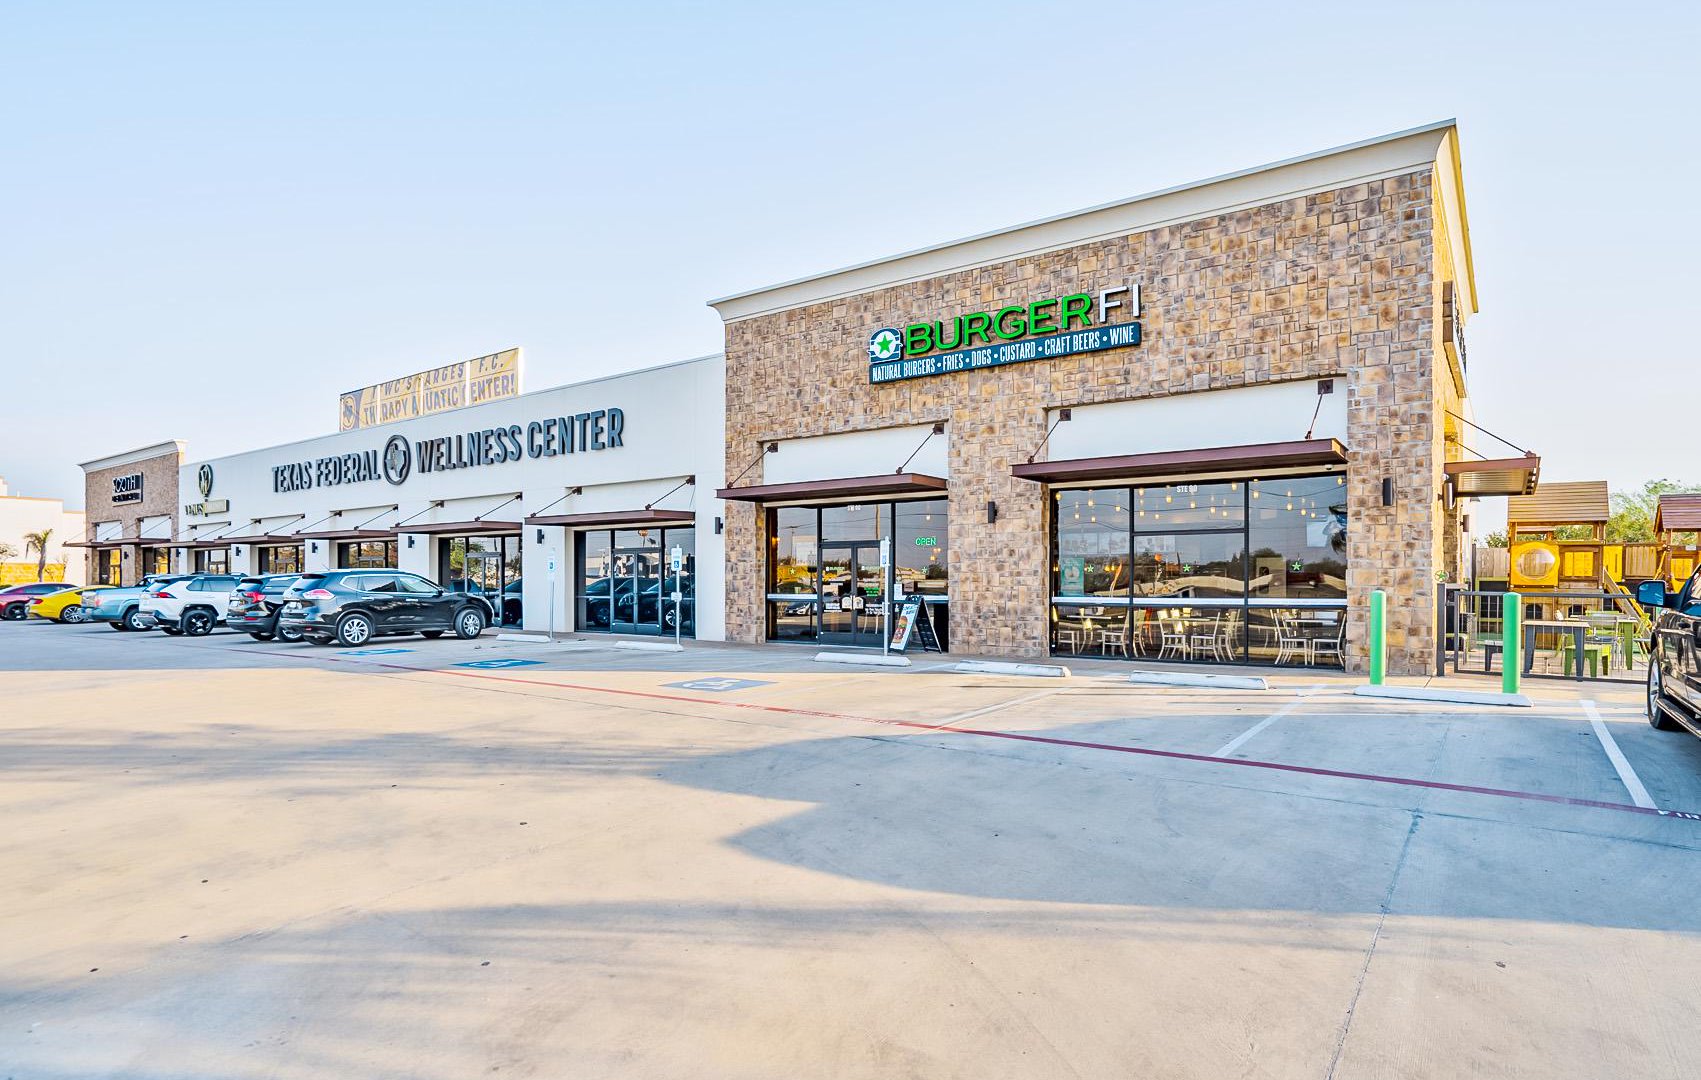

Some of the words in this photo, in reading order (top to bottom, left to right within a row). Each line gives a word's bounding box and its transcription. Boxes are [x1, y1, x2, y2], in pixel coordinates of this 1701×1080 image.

[905, 284, 1140, 355] BURGERFI
[873, 364, 902, 382] NATURAL
[904, 358, 936, 377] BURGERS
[943, 353, 964, 371] FRIES
[971, 348, 992, 367] DOGS
[1000, 341, 1036, 362] CUSTARD
[1044, 335, 1071, 356] CRAFT
[1073, 331, 1100, 352] BEERS
[1110, 325, 1135, 345] WINE
[424, 363, 465, 386] ARGES
[363, 396, 409, 426] THRAPY
[411, 386, 459, 416] AUATIC
[272, 460, 312, 493] TEXAS
[315, 449, 381, 488] FEDERAL
[415, 424, 522, 474] WELLNESS
[527, 407, 624, 459] CENTER
[1177, 485, 1188, 493] STE
[915, 537, 937, 547] OPEN
